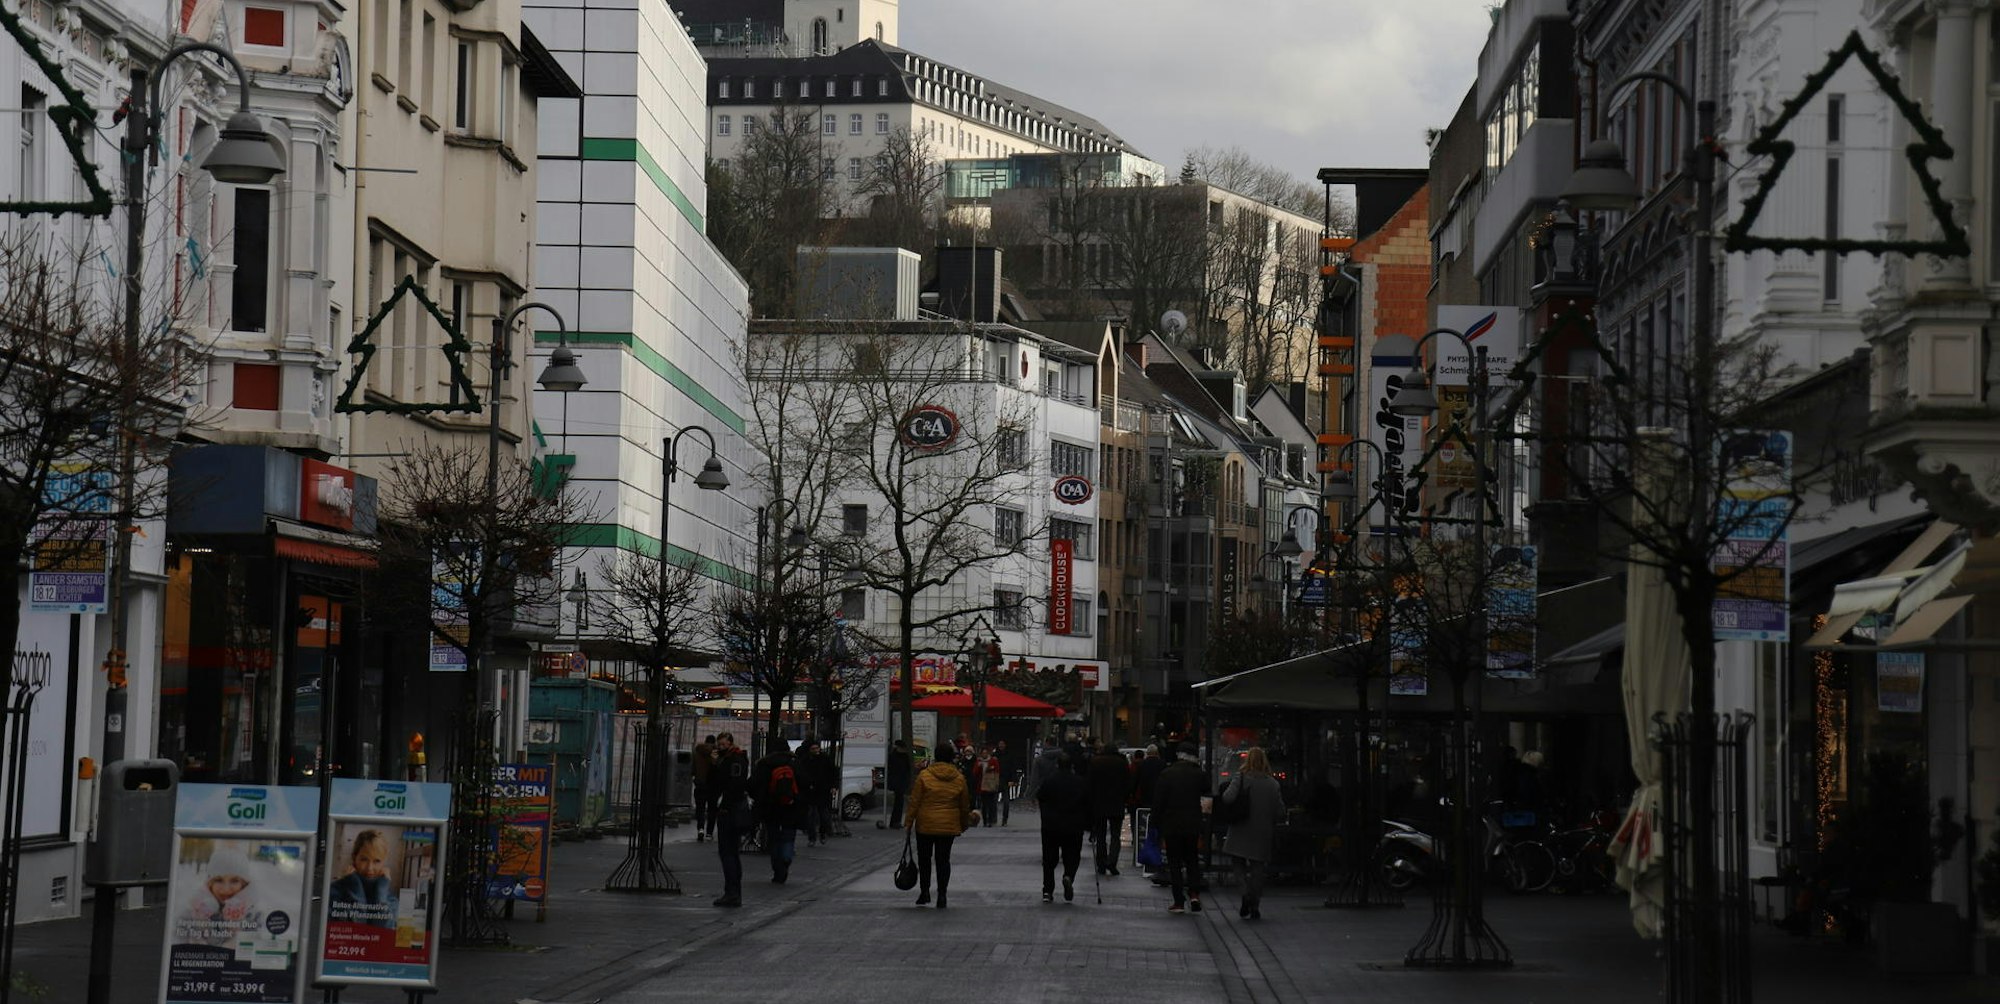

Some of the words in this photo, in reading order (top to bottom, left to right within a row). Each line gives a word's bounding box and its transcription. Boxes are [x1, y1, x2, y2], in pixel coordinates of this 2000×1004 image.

[910, 416, 948, 438] C&A
[1060, 482, 1084, 497] C&A
[34, 574, 65, 585] LANGER
[66, 575, 104, 585] SAMSTAG
[518, 767, 547, 782] MIT
[374, 795, 406, 809] Goll
[228, 802, 266, 819] Goll
[242, 920, 257, 929] Duo
[338, 946, 360, 956] 22,99
[360, 947, 366, 956] €
[181, 960, 225, 968] REGENERATION
[184, 982, 208, 993] 31,99
[208, 982, 216, 992] €
[232, 983, 257, 994] 33,99
[258, 983, 265, 993] €
